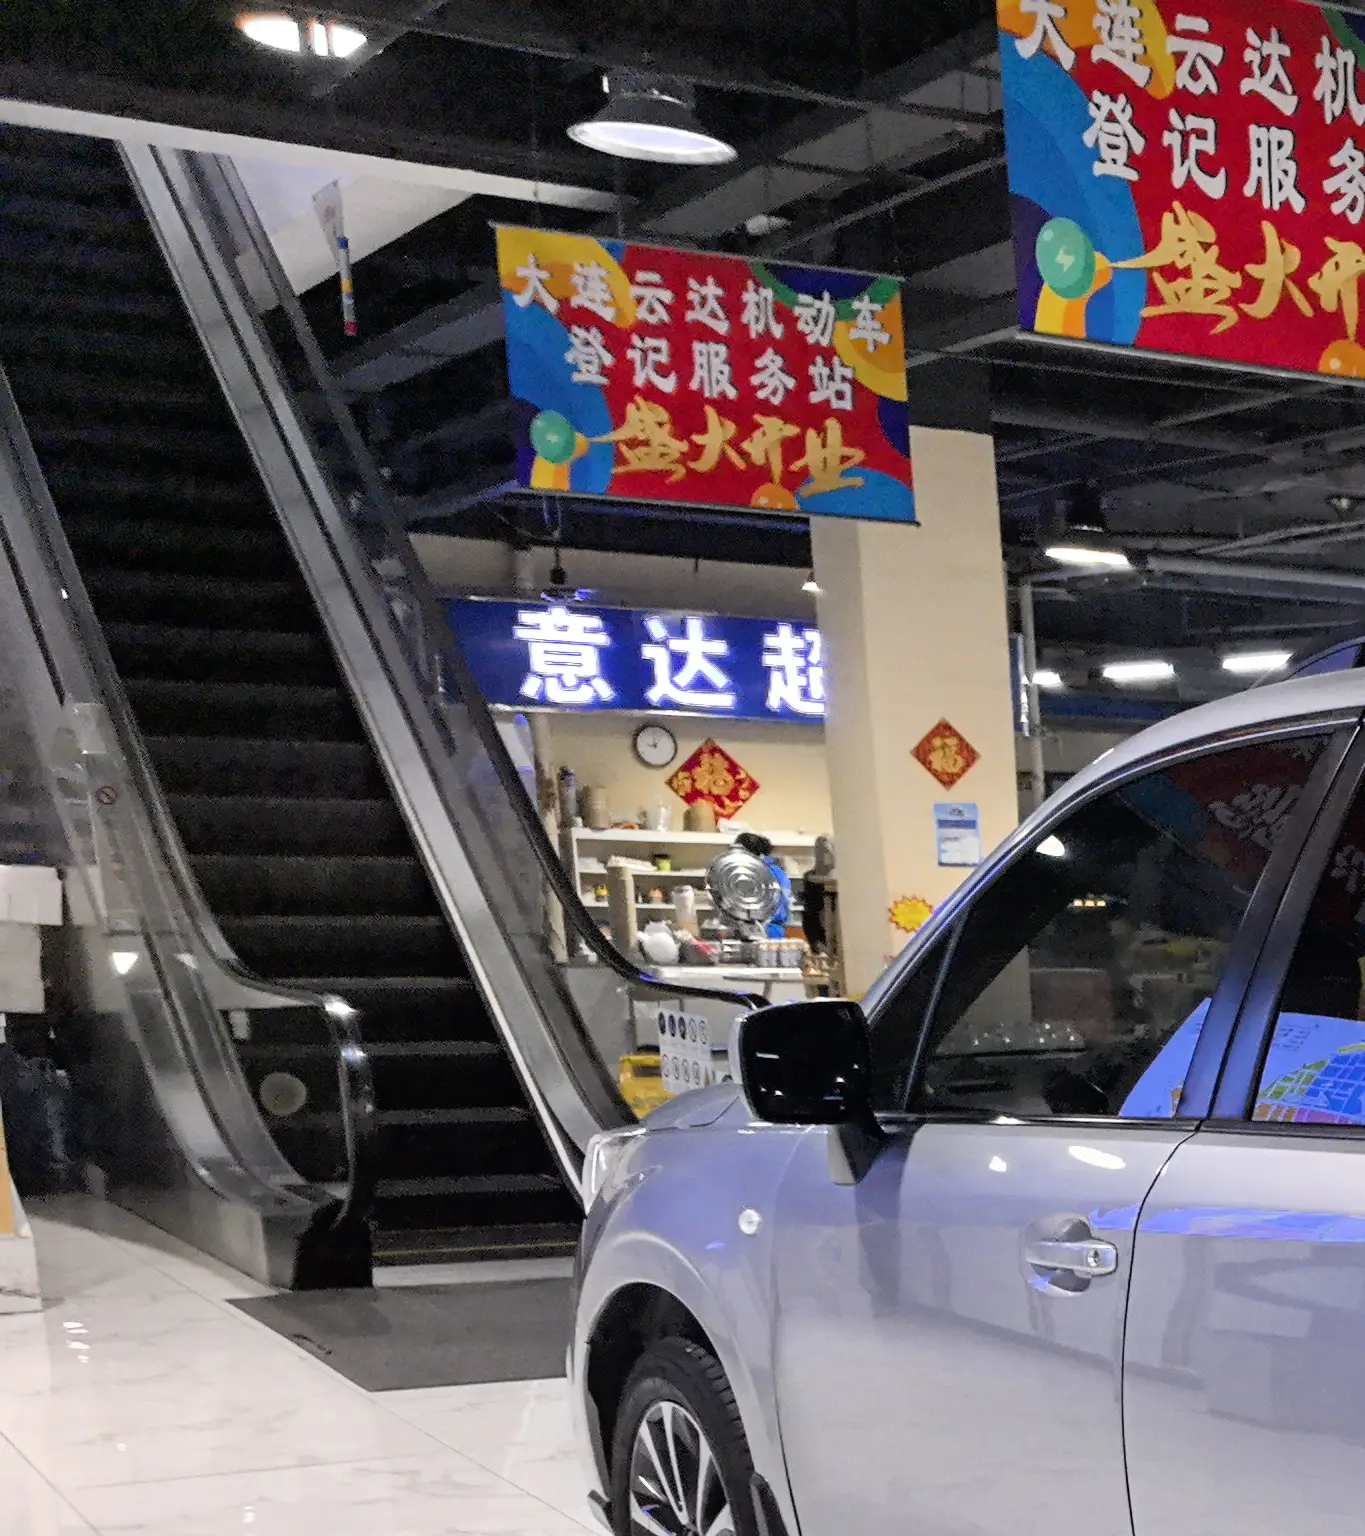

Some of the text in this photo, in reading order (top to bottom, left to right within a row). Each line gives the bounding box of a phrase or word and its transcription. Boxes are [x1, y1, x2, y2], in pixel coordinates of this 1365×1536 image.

[515, 253, 891, 352] 大连云达机动车
[565, 325, 855, 411] 登记服务站
[588, 395, 866, 497] 盛大开业
[513, 605, 826, 715] 意达超
